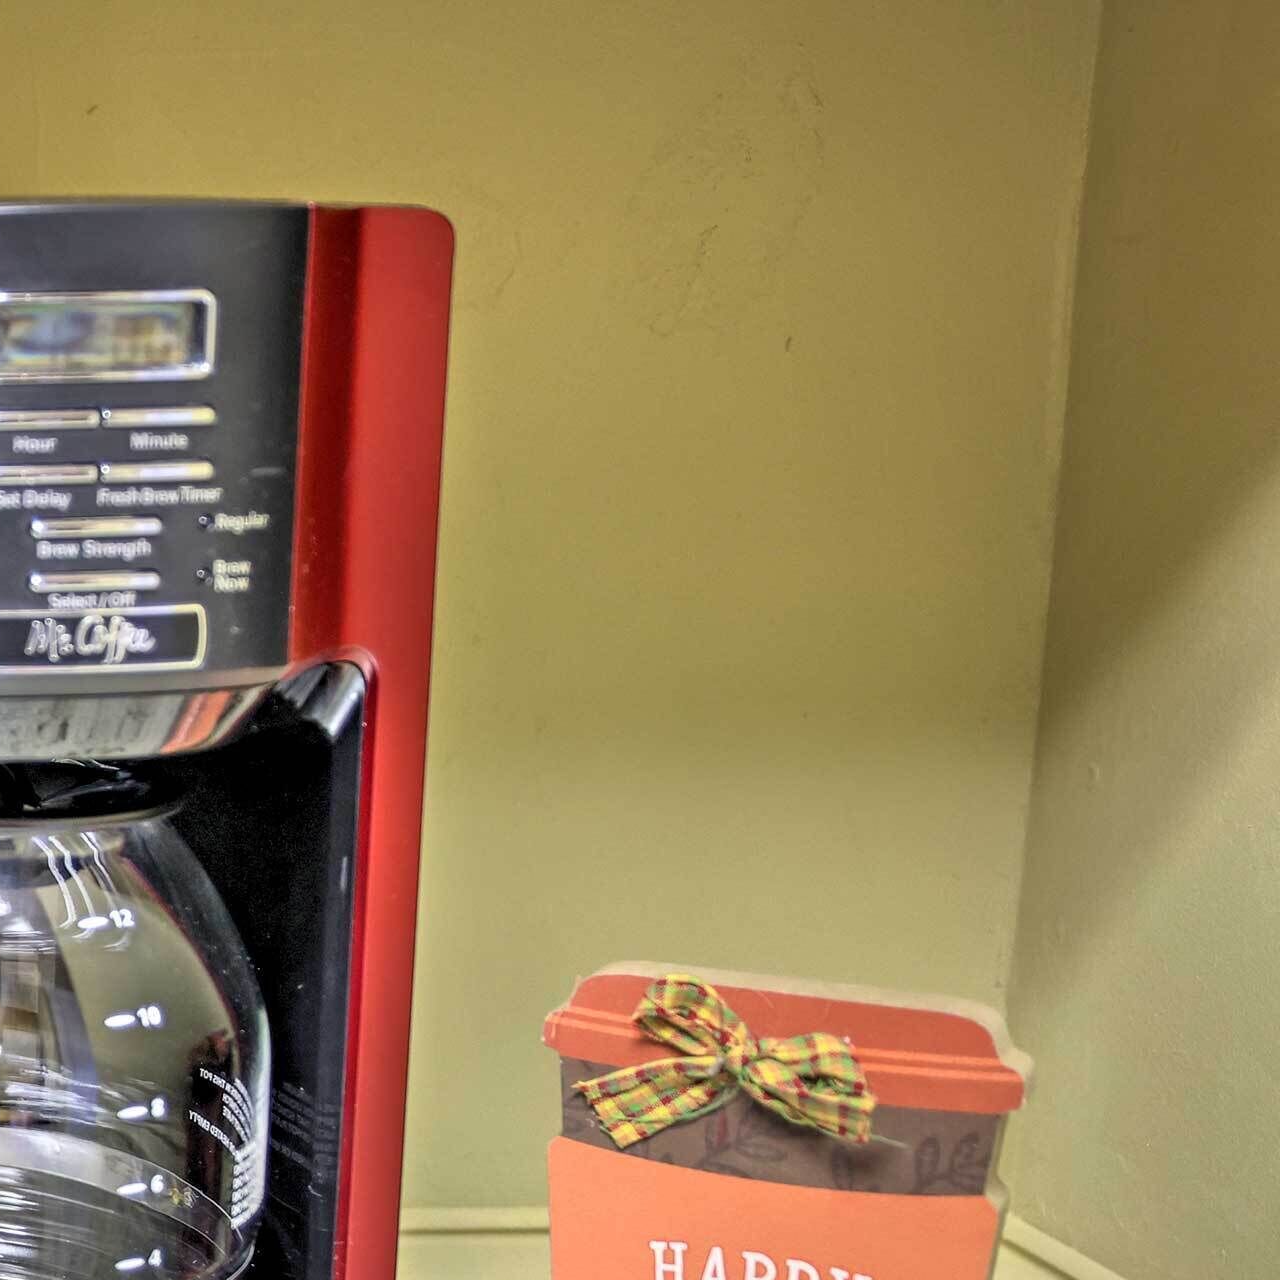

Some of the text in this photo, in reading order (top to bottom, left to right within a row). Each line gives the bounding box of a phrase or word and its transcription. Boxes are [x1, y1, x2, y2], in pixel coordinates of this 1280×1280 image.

[12, 435, 58, 453] Hour
[130, 432, 189, 450] Minute
[22, 489, 72, 511] Delay
[96, 485, 223, 506] Fresh Brew Timer
[214, 511, 270, 535] Regular
[36, 538, 151, 561] Brew Strength
[212, 559, 251, 576] Brew
[213, 575, 250, 592] Now
[75, 615, 156, 664] Coffee
[109, 909, 135, 929] 12
[137, 1005, 162, 1028] 10
[150, 1098, 165, 1118] 8
[150, 1174, 163, 1194] 6
[148, 1249, 162, 1267] 4
